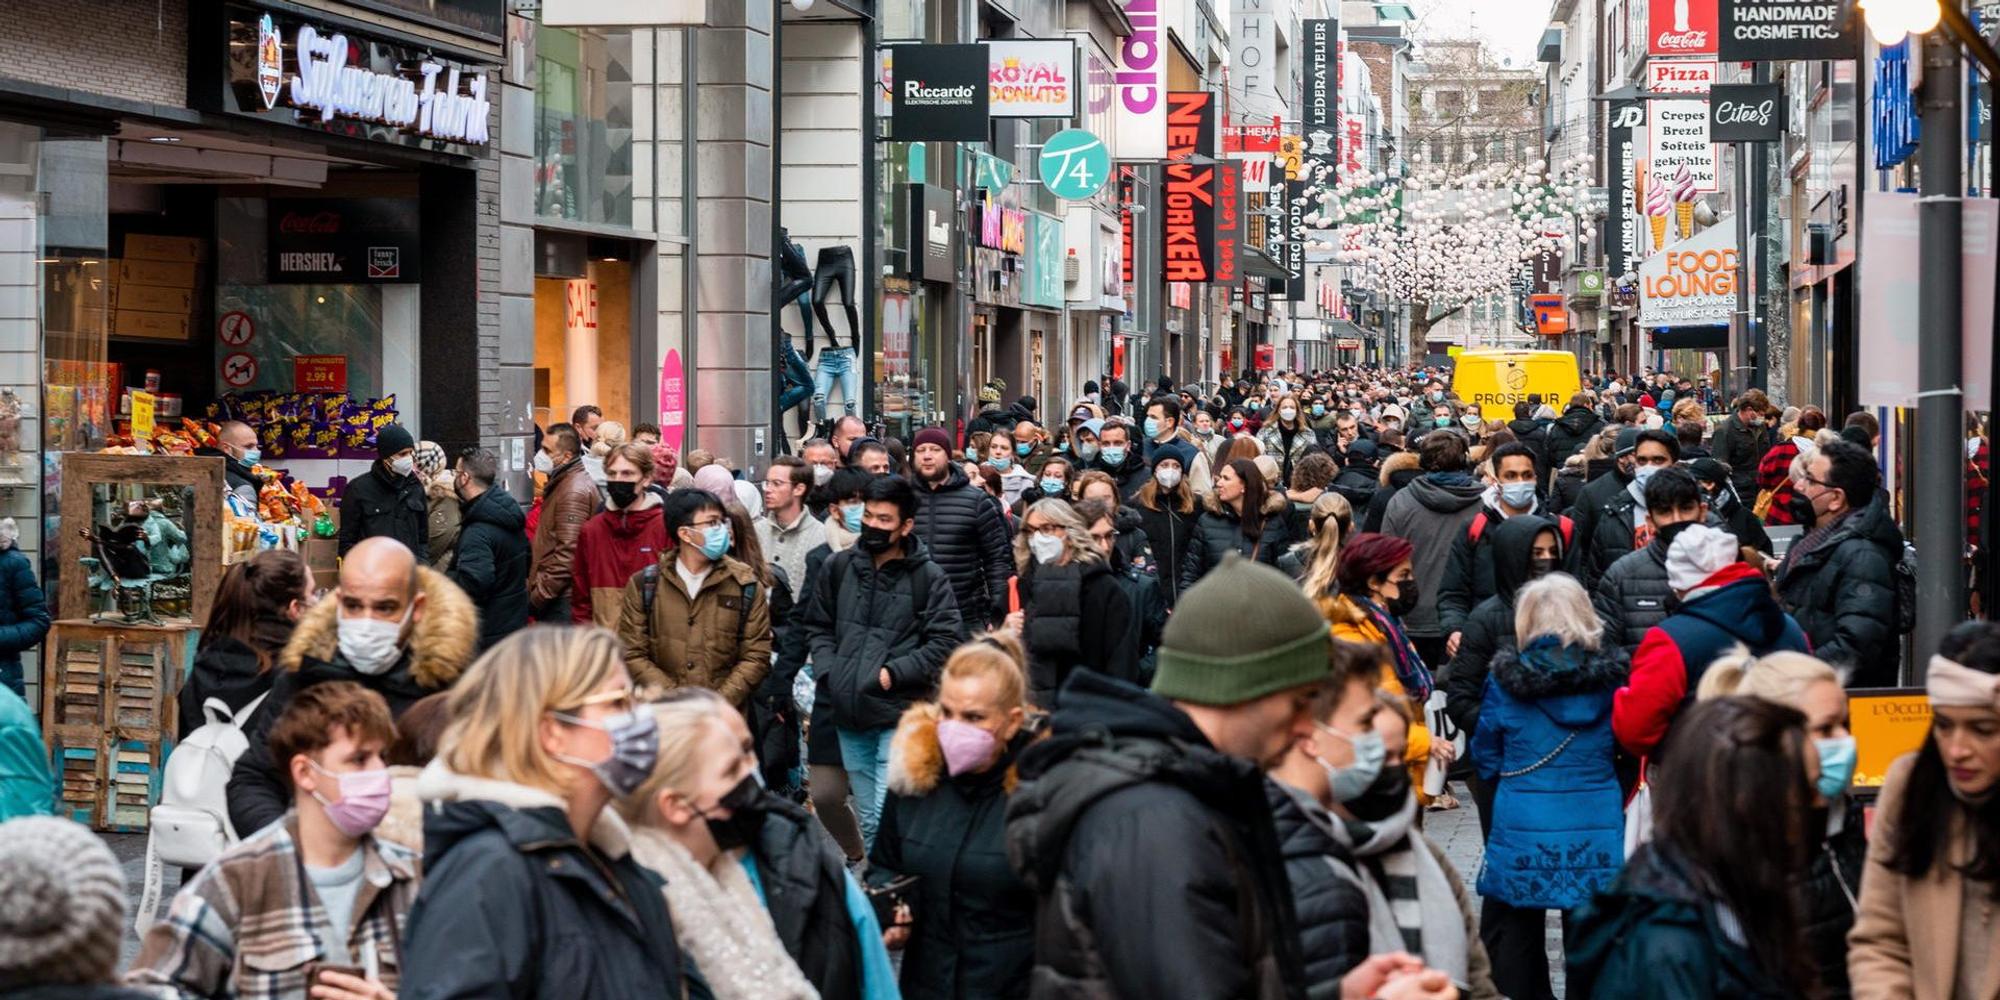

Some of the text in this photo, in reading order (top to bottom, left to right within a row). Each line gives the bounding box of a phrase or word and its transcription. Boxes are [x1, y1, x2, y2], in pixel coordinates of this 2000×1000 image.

[1116, 0, 1158, 114] clai
[1314, 22, 1326, 125] LEDERATELIER
[1656, 67, 1710, 81] Pizza
[989, 84, 1067, 104] DONUTS
[1612, 106, 1643, 129] JD
[1661, 110, 1705, 122] Crepes
[1247, 127, 1279, 137] HEMA
[1662, 125, 1704, 136] Brezel
[1660, 141, 1706, 151] Softeis
[1621, 141, 1633, 206] TRAINERS
[1653, 171, 1714, 182] Getnke
[1290, 198, 1301, 279] VERO MODA
[1622, 219, 1633, 253] KING
[1666, 249, 1740, 275] FOOD
[567, 282, 598, 328] SALE
[1474, 392, 1560, 405] PROSEUR
